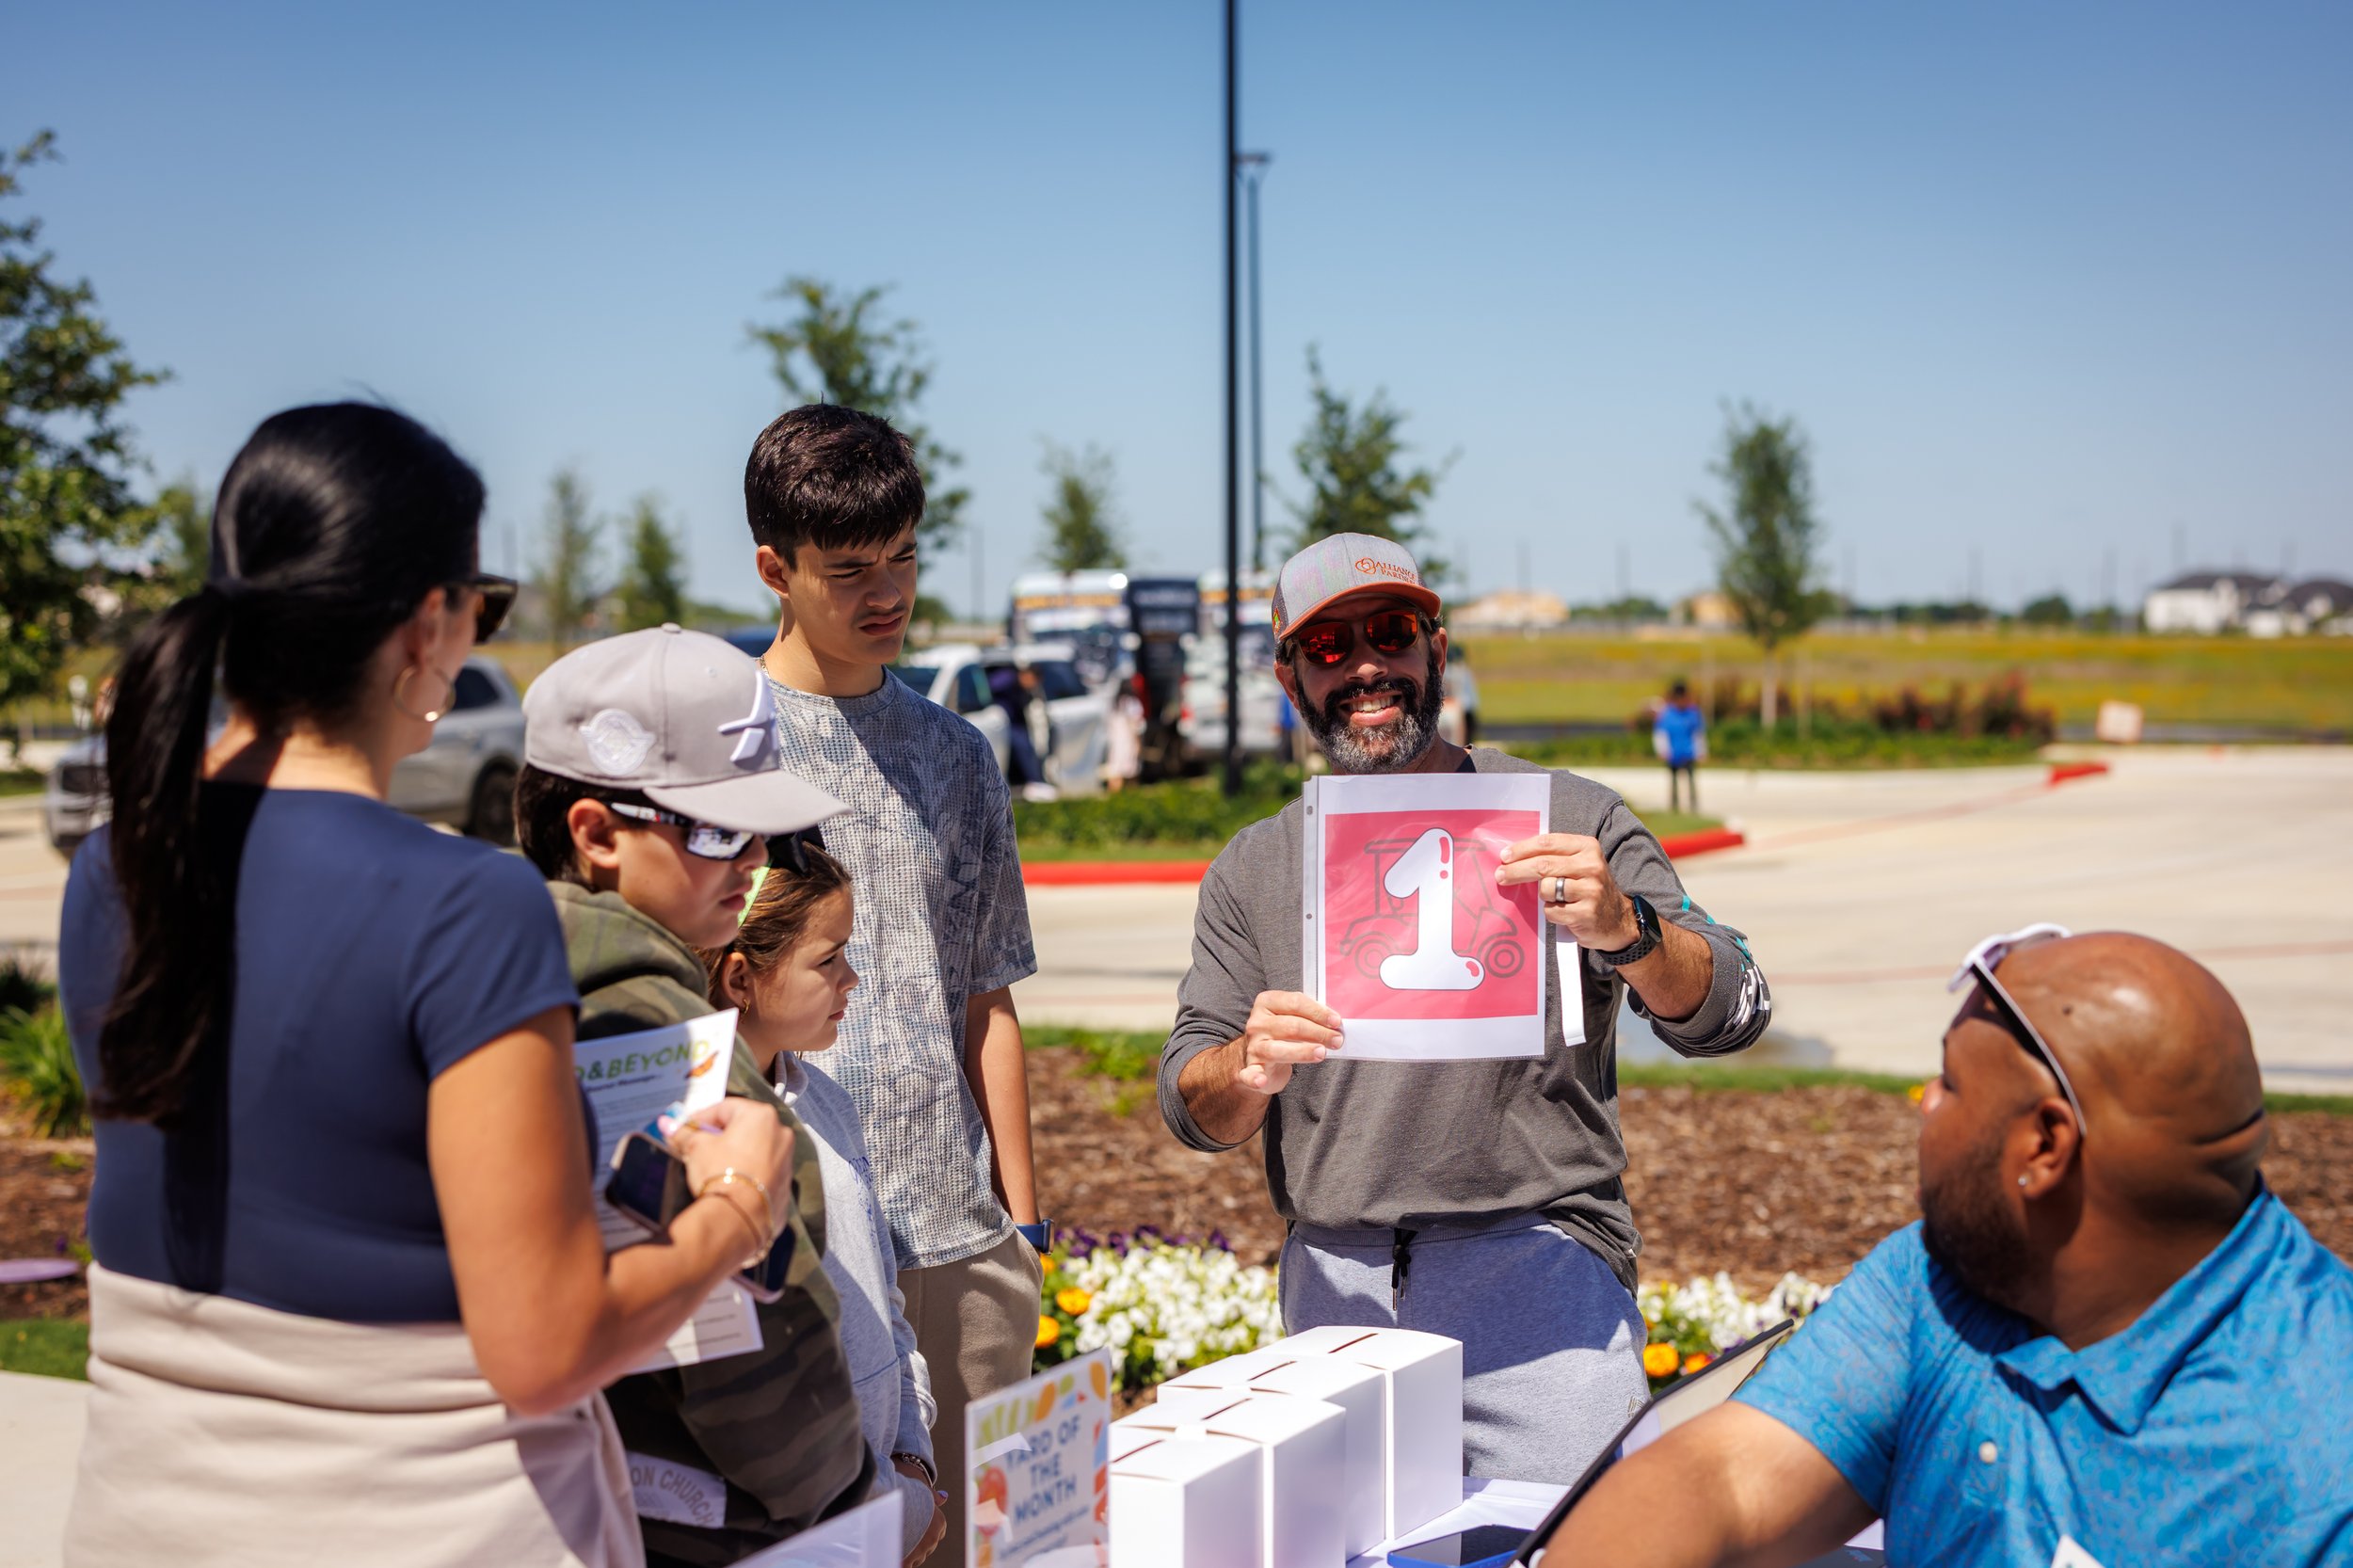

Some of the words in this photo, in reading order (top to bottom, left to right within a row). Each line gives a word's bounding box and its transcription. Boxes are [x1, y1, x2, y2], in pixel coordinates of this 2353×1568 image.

[1375, 561, 1416, 581] ALLIANCE
[1379, 827, 1485, 991] 1
[1057, 1414, 1080, 1446] OF
[660, 1468, 714, 1525] CHURCH
[1015, 1474, 1078, 1525] MONTH
